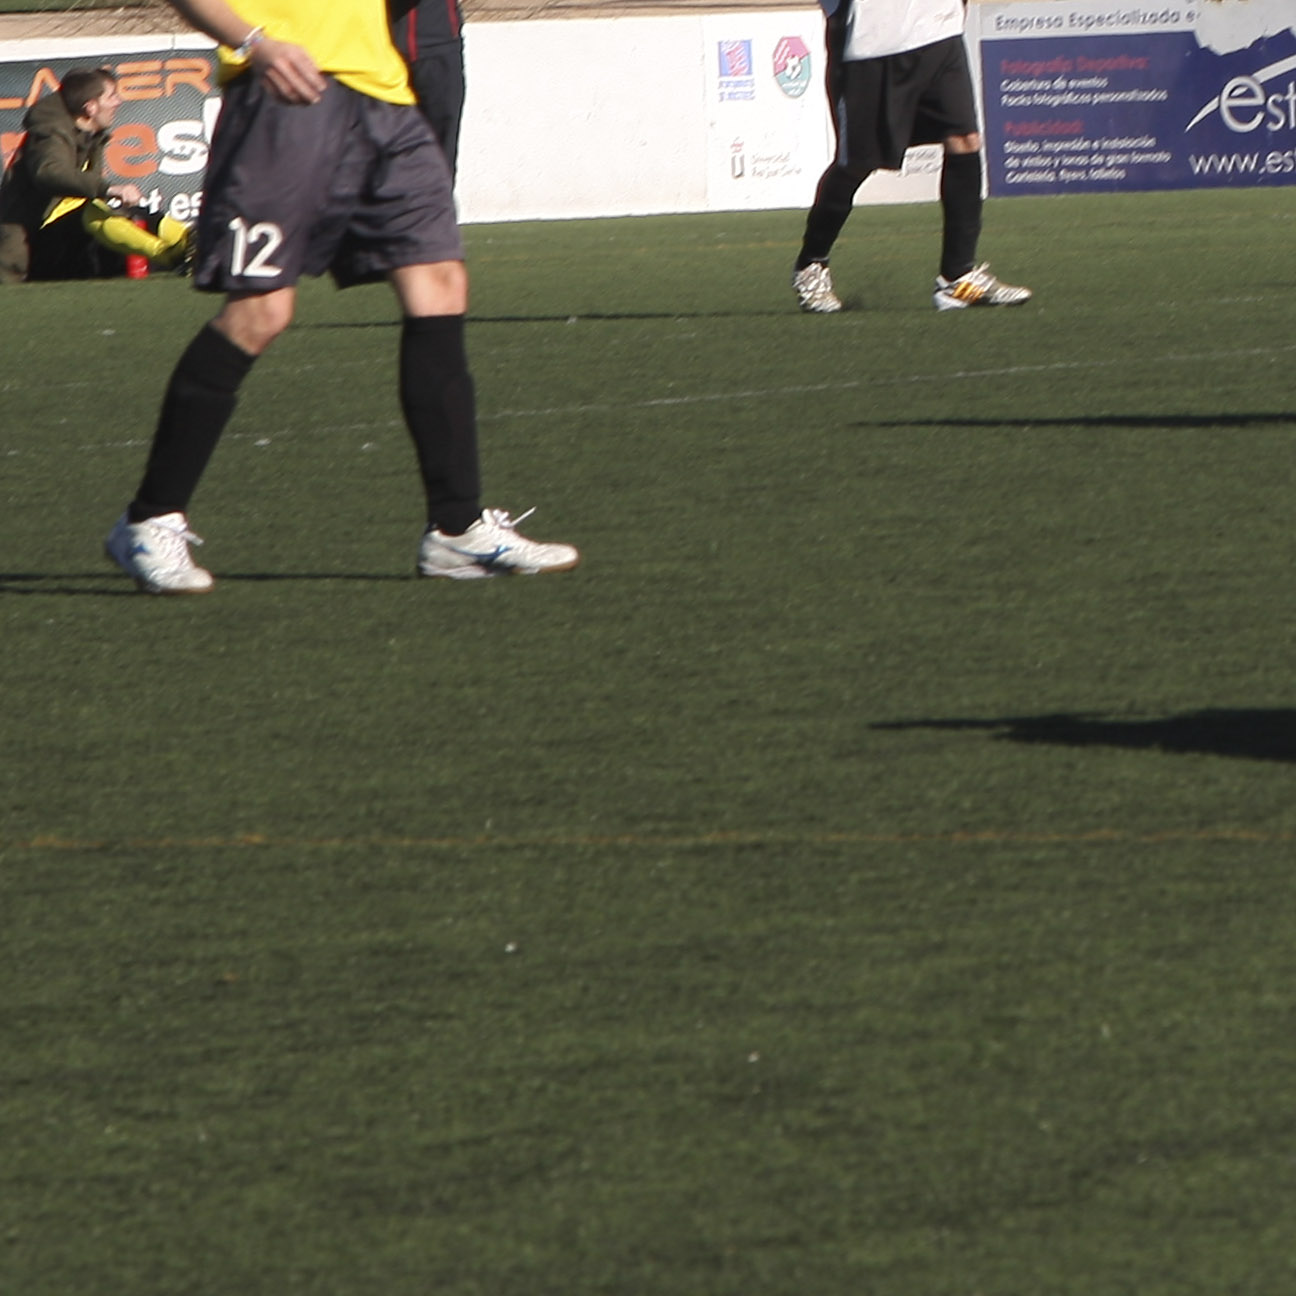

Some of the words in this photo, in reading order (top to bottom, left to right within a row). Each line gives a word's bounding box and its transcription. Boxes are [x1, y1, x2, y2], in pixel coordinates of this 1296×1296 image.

[995, 14, 1063, 33] Empresa
[1068, 7, 1181, 31] Especializada
[228, 217, 283, 278] 12
